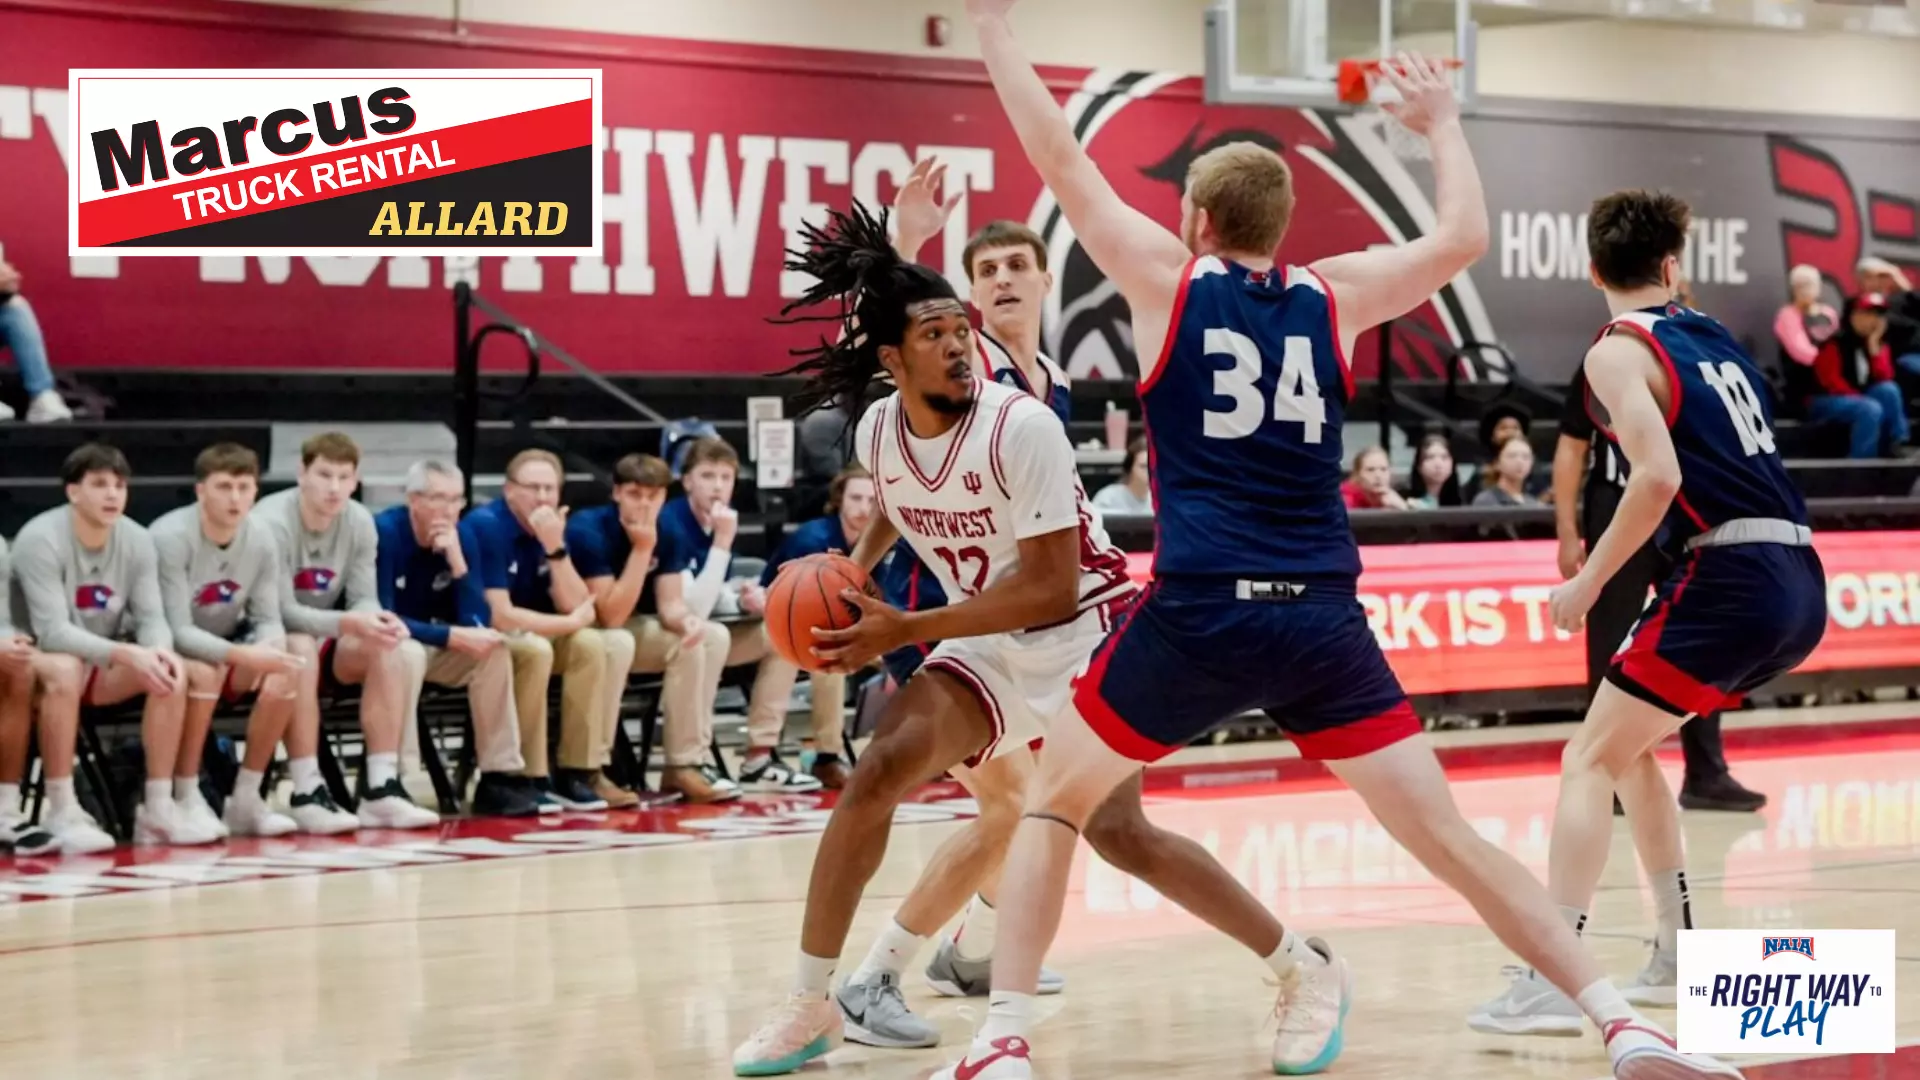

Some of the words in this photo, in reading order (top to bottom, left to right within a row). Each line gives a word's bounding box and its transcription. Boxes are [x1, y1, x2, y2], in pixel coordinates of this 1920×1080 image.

[1501, 211, 1591, 280] HOM
[1203, 327, 1327, 444] 34
[1447, 588, 1506, 646] IS
